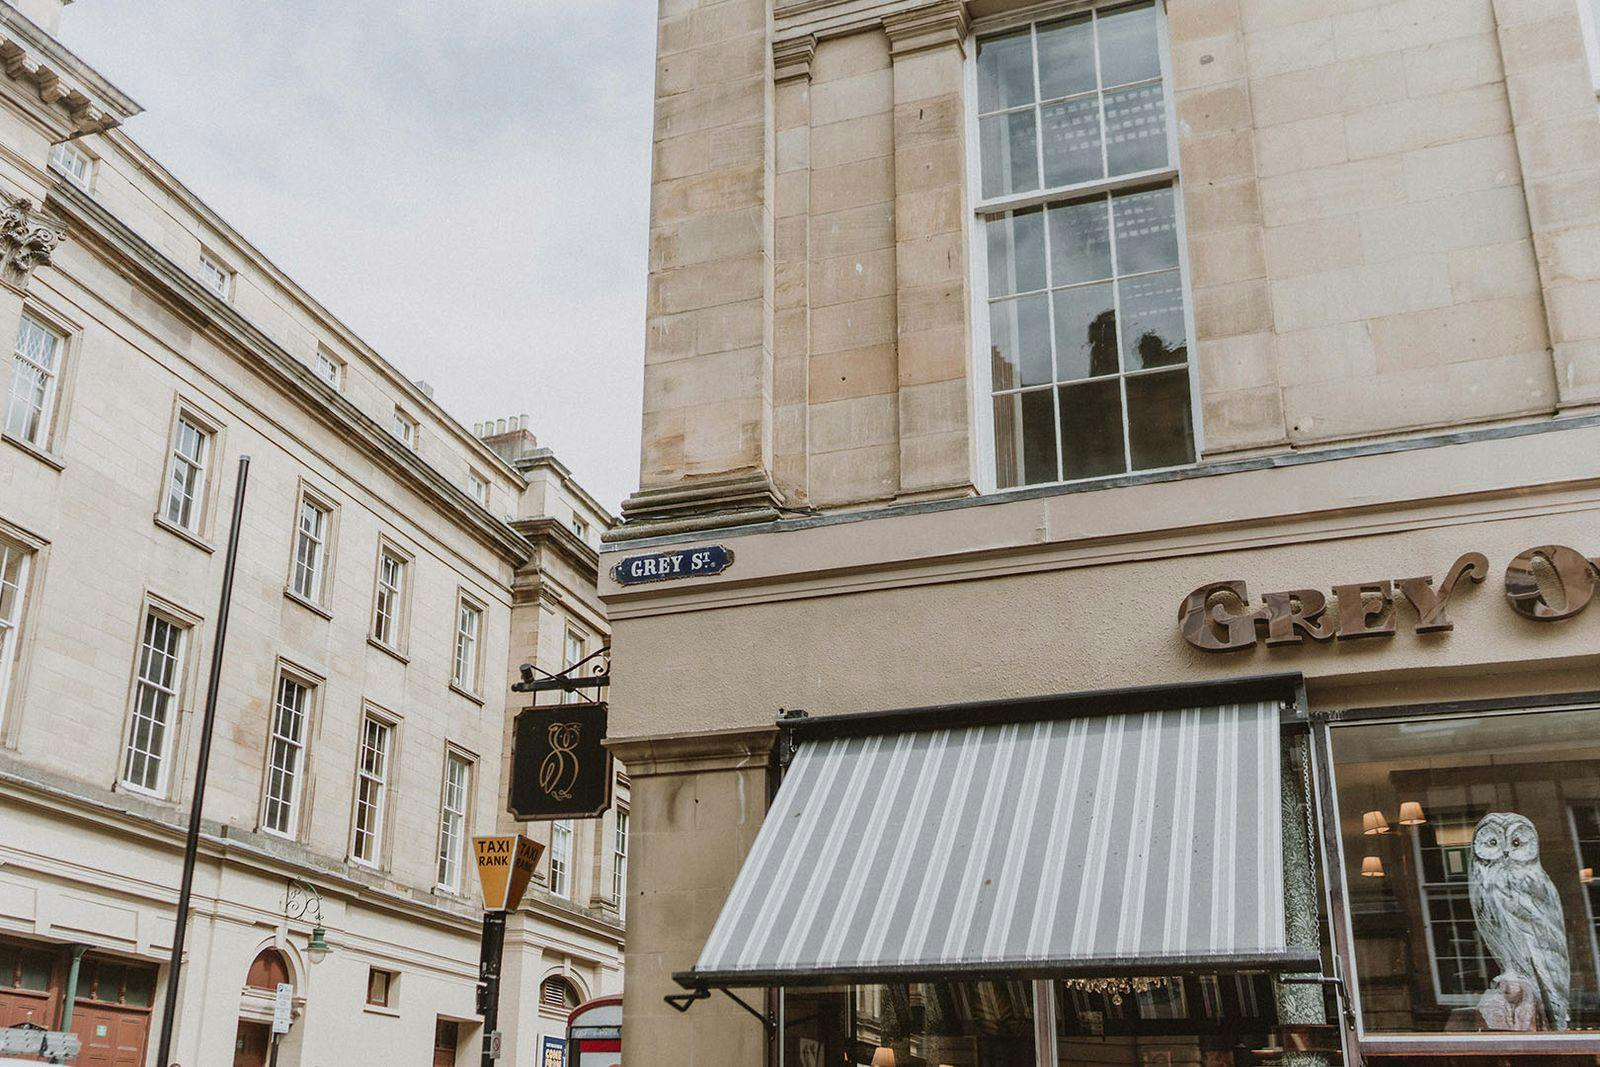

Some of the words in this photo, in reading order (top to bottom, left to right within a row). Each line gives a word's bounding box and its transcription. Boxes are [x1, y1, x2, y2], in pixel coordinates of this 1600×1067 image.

[631, 555, 683, 577] GREY
[1177, 551, 1490, 654] GREY
[1504, 544, 1600, 622] O
[478, 840, 509, 853] TAXI
[519, 841, 538, 863] TAXI
[478, 855, 508, 867] RANK
